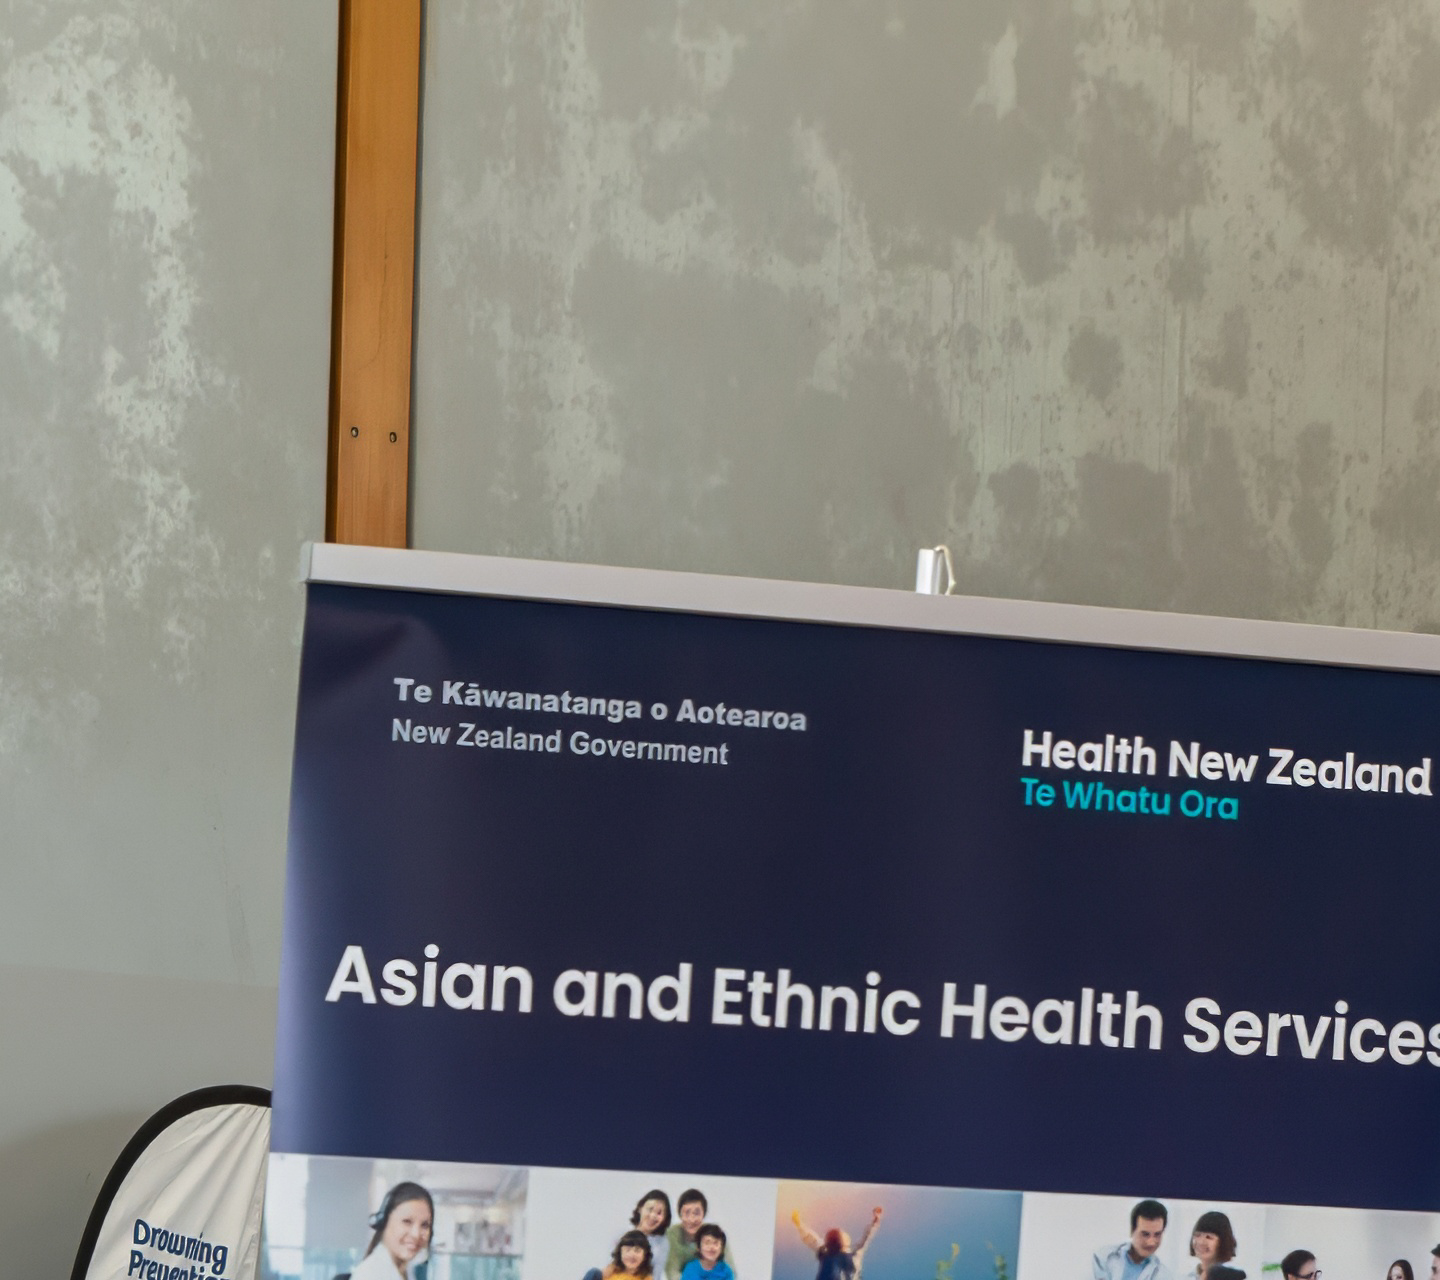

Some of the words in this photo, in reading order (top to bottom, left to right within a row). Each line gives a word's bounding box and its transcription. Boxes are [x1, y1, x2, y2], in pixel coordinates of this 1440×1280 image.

[393, 677, 432, 703] Te
[441, 680, 642, 723] Kāwanatanga
[650, 700, 668, 721] o
[675, 698, 807, 732] Aotearoa
[391, 718, 451, 745] New
[456, 723, 563, 753] Zealand
[569, 731, 729, 765] Government
[1022, 729, 1156, 776] Health
[1168, 740, 1259, 783] New
[1266, 748, 1434, 797] Zealand
[1020, 777, 1055, 807] Te
[1063, 781, 1171, 816] Whatu
[1179, 789, 1239, 821] Ora
[325, 943, 534, 1014] Asian
[552, 961, 693, 1026] and
[711, 967, 922, 1038] Ethnic
[939, 981, 1163, 1056] Health
[133, 1219, 228, 1276] Drowning
